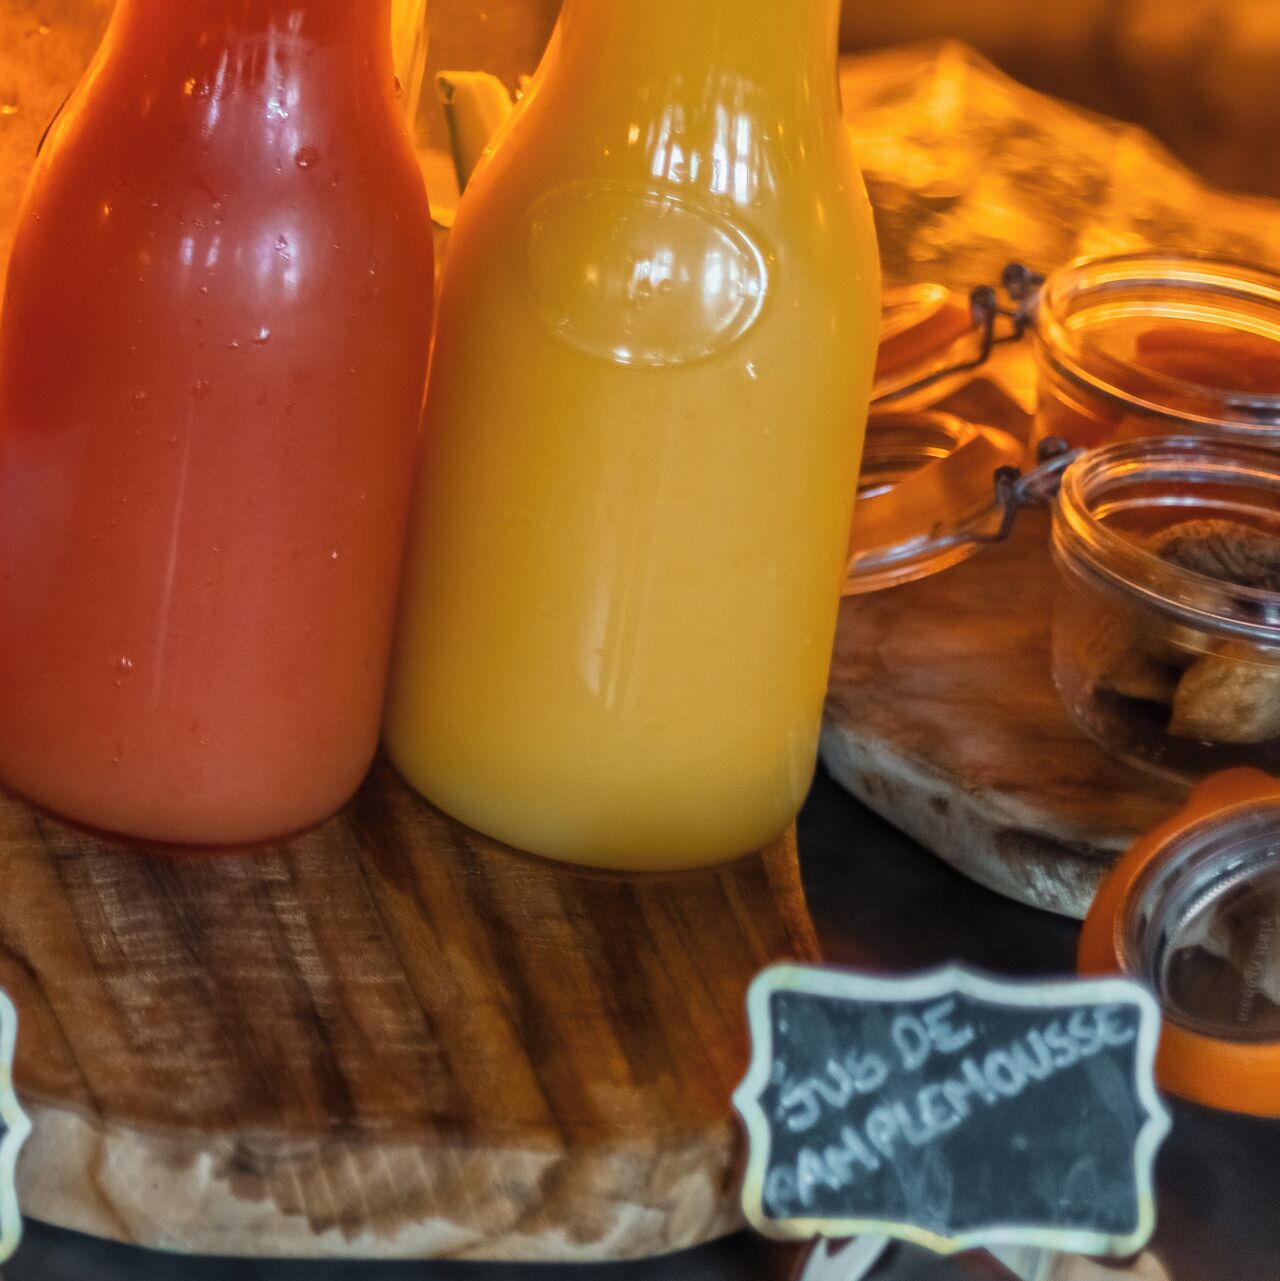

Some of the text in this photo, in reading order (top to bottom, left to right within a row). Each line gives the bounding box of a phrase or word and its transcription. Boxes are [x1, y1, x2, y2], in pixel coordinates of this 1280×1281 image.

[765, 1002, 1136, 1217] PAMPLEMOUSSE
[774, 998, 975, 1132] JUS DE
